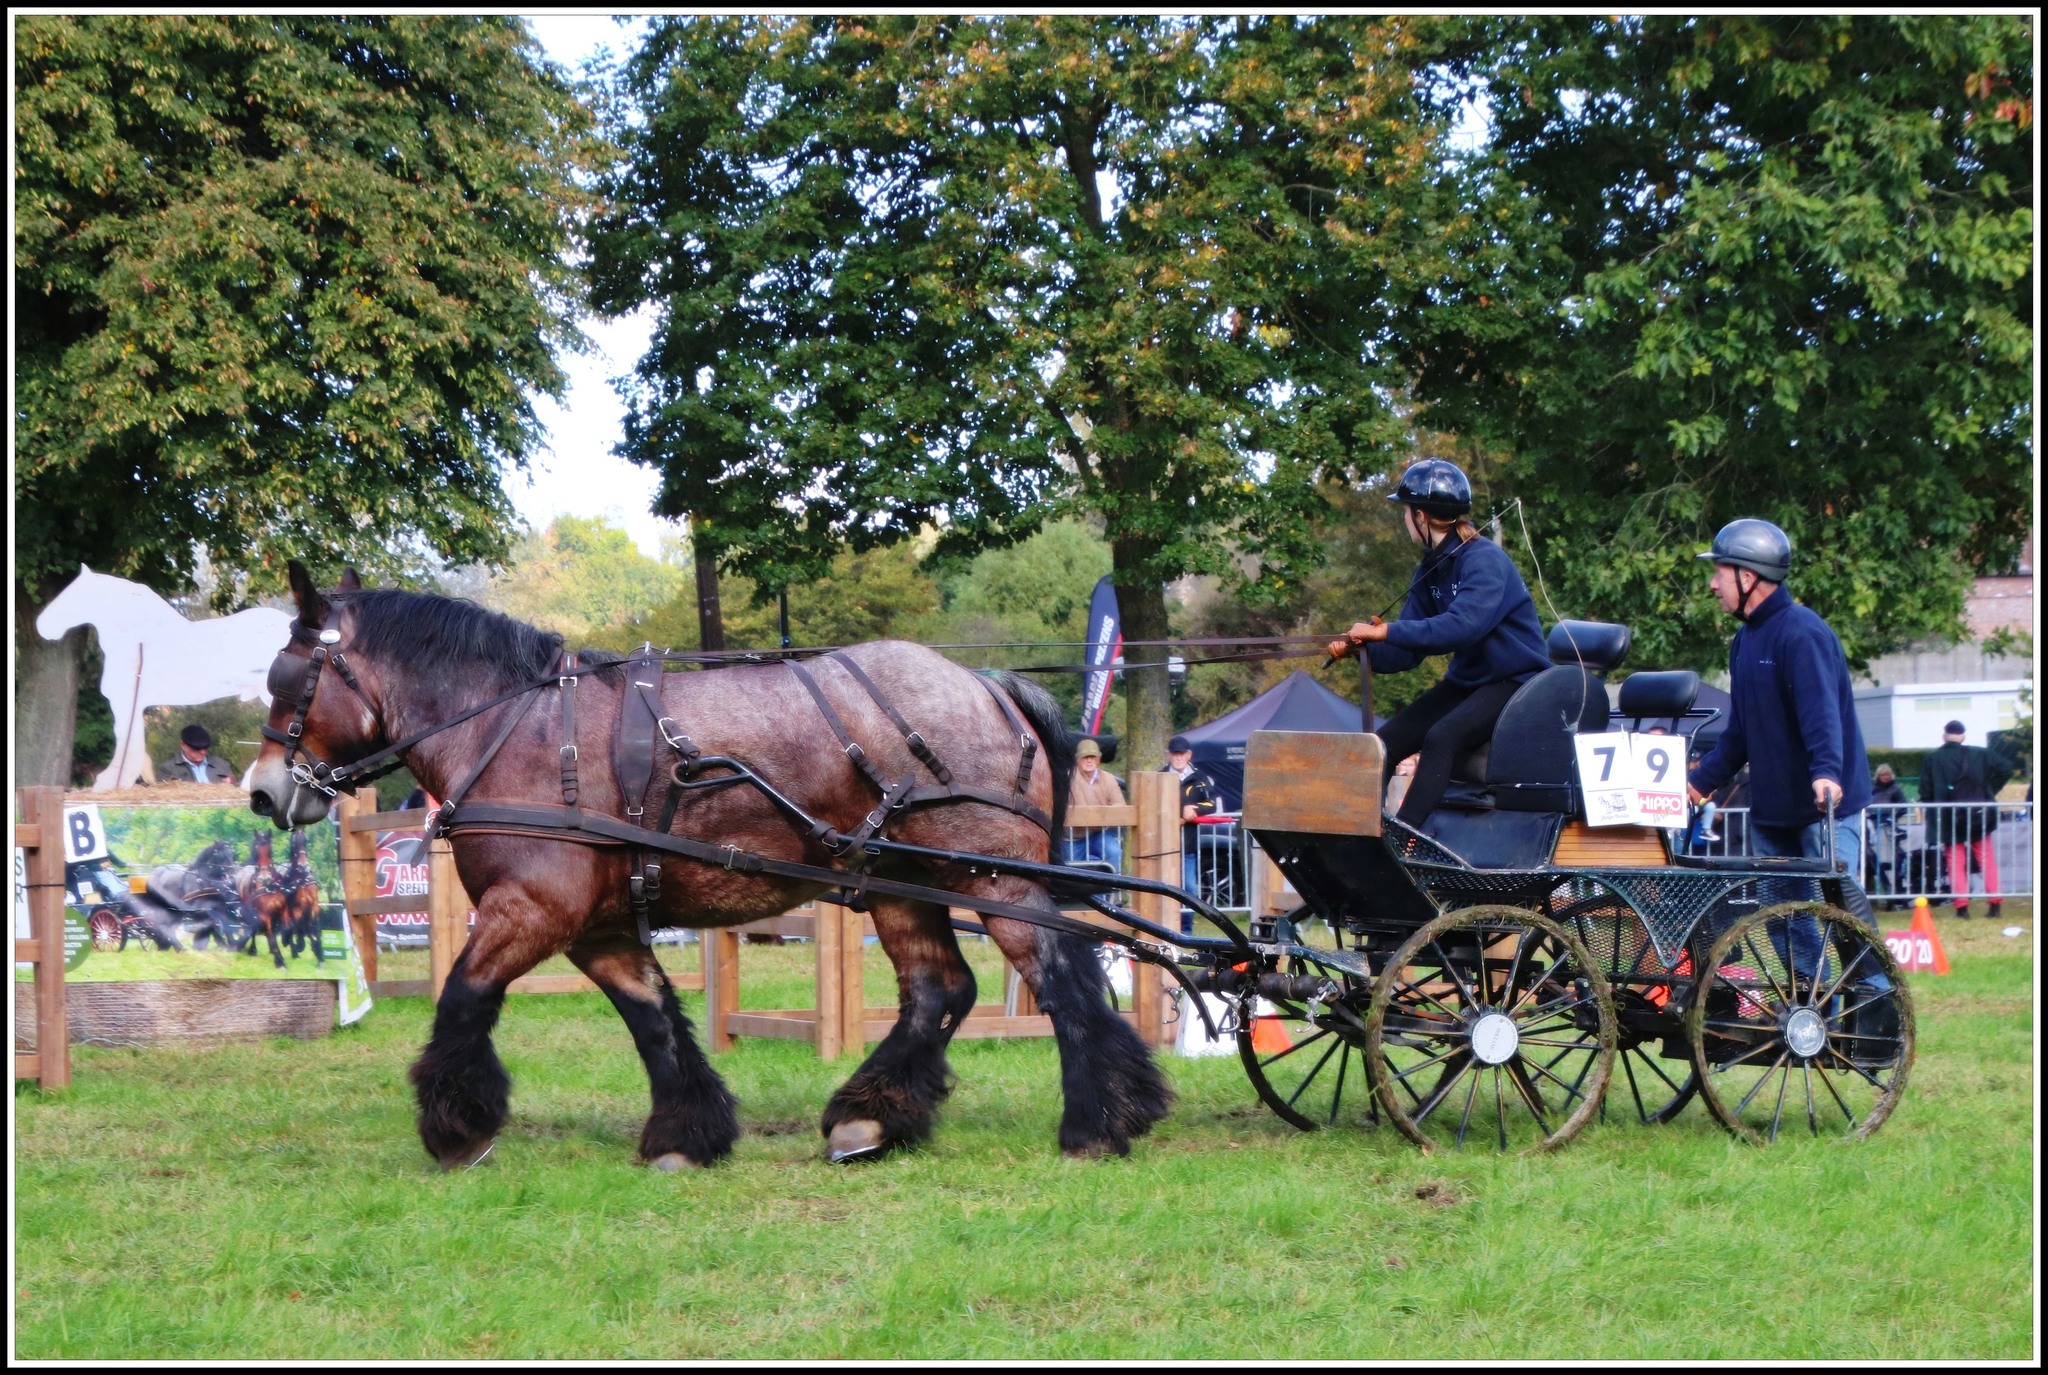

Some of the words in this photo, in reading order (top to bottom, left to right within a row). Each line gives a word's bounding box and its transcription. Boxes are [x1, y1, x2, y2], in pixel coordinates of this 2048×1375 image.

[1593, 746, 1616, 782] 7
[1646, 748, 1670, 783] 9
[1638, 795, 1682, 812] HIPPO
[68, 811, 95, 857] B
